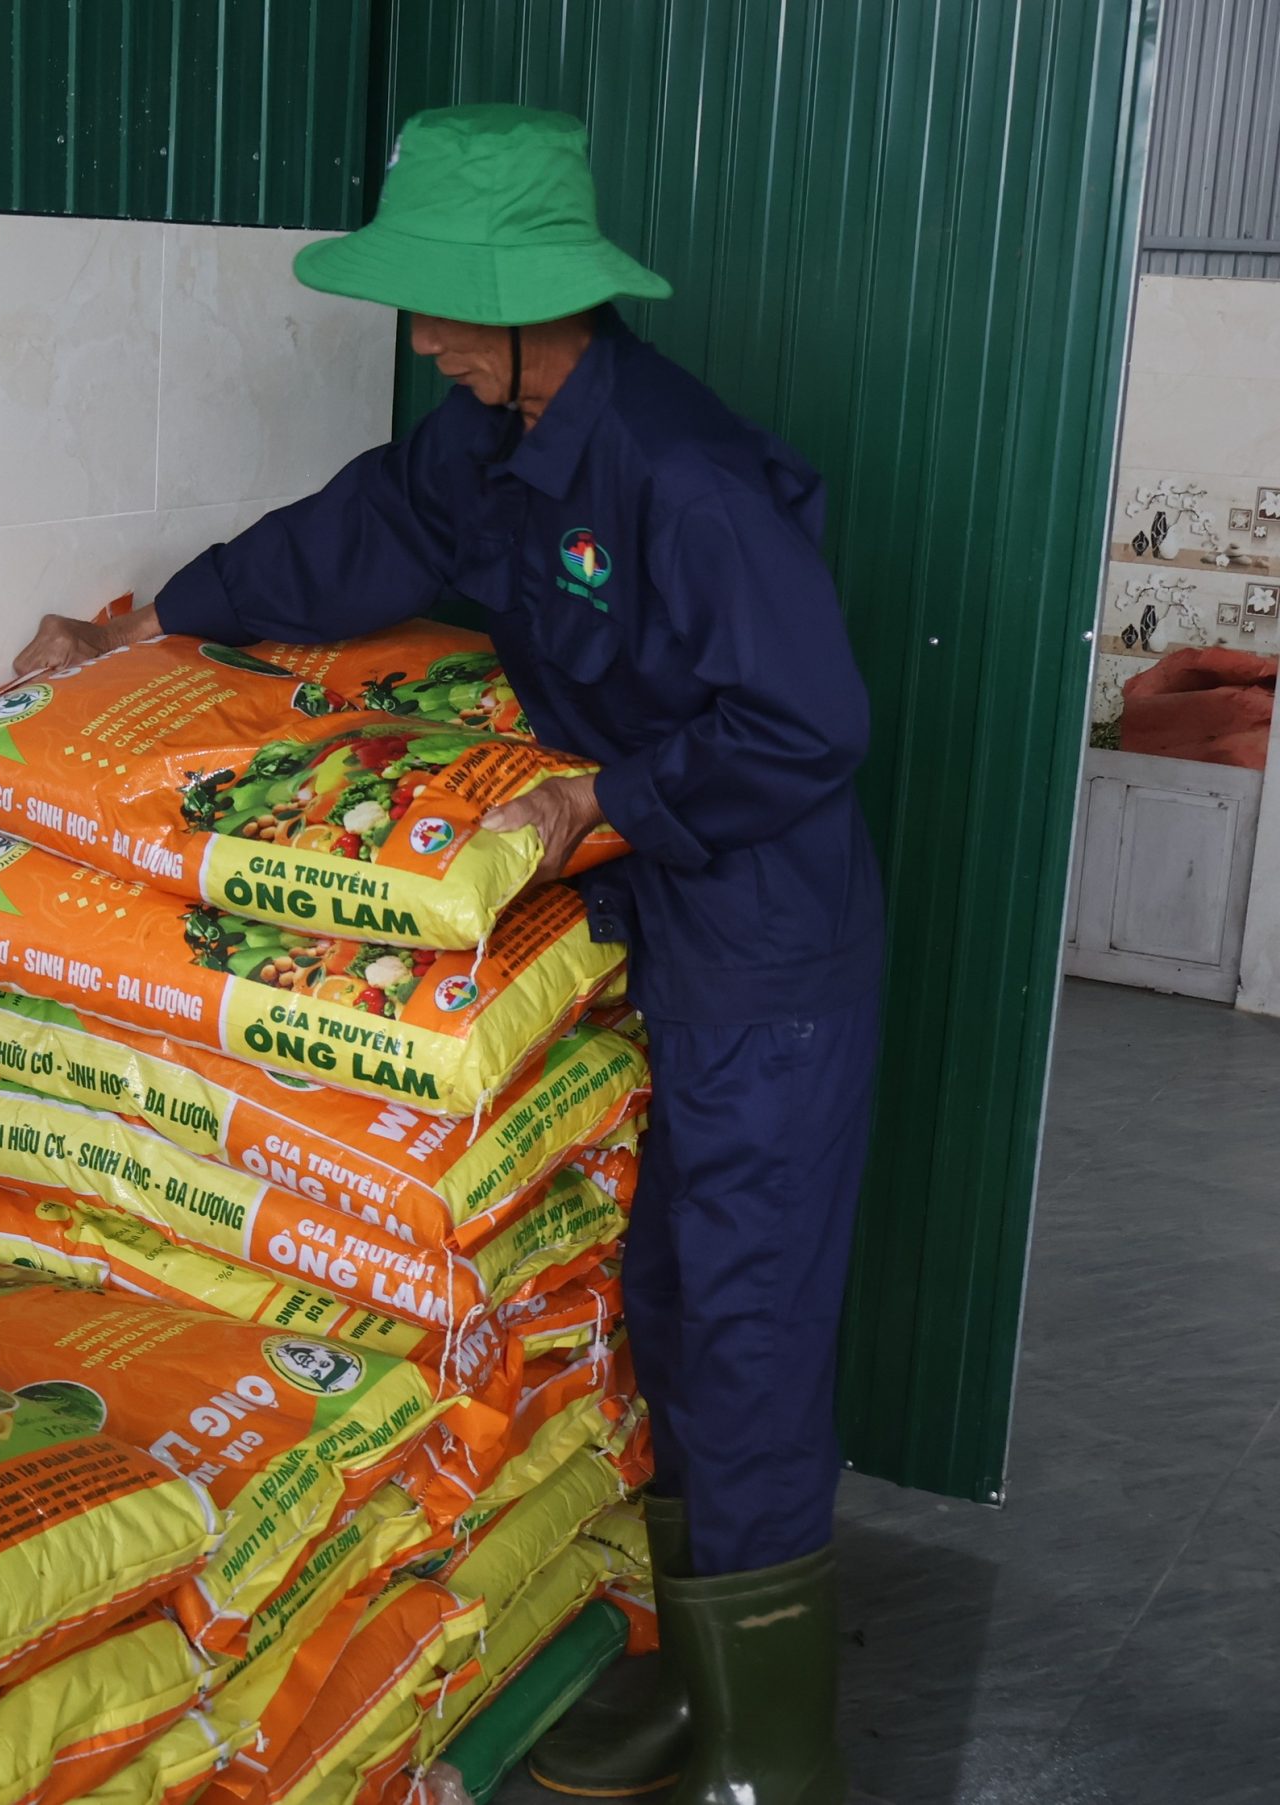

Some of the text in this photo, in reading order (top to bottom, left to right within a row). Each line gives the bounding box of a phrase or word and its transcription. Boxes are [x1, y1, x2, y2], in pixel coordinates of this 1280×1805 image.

[81, 712, 110, 736] DINH
[26, 797, 63, 832] SINH
[67, 812, 99, 846] HỌC
[132, 836, 183, 880] LƯỢNG
[224, 871, 421, 937] ÔNG LAM
[249, 856, 390, 900] GIA TRUYỀN 1
[24, 948, 64, 982] SINH
[68, 960, 103, 994] HỌC
[117, 974, 142, 1002] ĐA
[144, 982, 204, 1022] LƯỢNG
[244, 1018, 440, 1100] ÔNG LAM
[270, 1005, 414, 1059] GIA TRUYỀN 1
[30, 1051, 54, 1076] CƠ
[143, 1086, 165, 1118] ĐA
[551, 1077, 572, 1100] LAM
[8, 1122, 39, 1155] HỮU
[43, 1132, 66, 1160] CƠ
[77, 1142, 121, 1175] SINH
[165, 1176, 187, 1207] ĐA
[189, 1185, 245, 1231] LƯỢNG
[241, 1144, 327, 1203] ÔNG
[265, 1135, 301, 1165] GIA
[307, 1153, 387, 1204] TRUYỀN
[268, 1229, 359, 1289] ÔNG
[297, 1218, 436, 1284] GIA TRUYỀN 1
[349, 1312, 378, 1340] CANADA
[189, 1375, 280, 1437] ÔNG
[219, 1430, 265, 1464] GIA
[256, 1516, 277, 1541] ĐA
[337, 1524, 362, 1550] ÔNG
[312, 1544, 338, 1575] LAM
